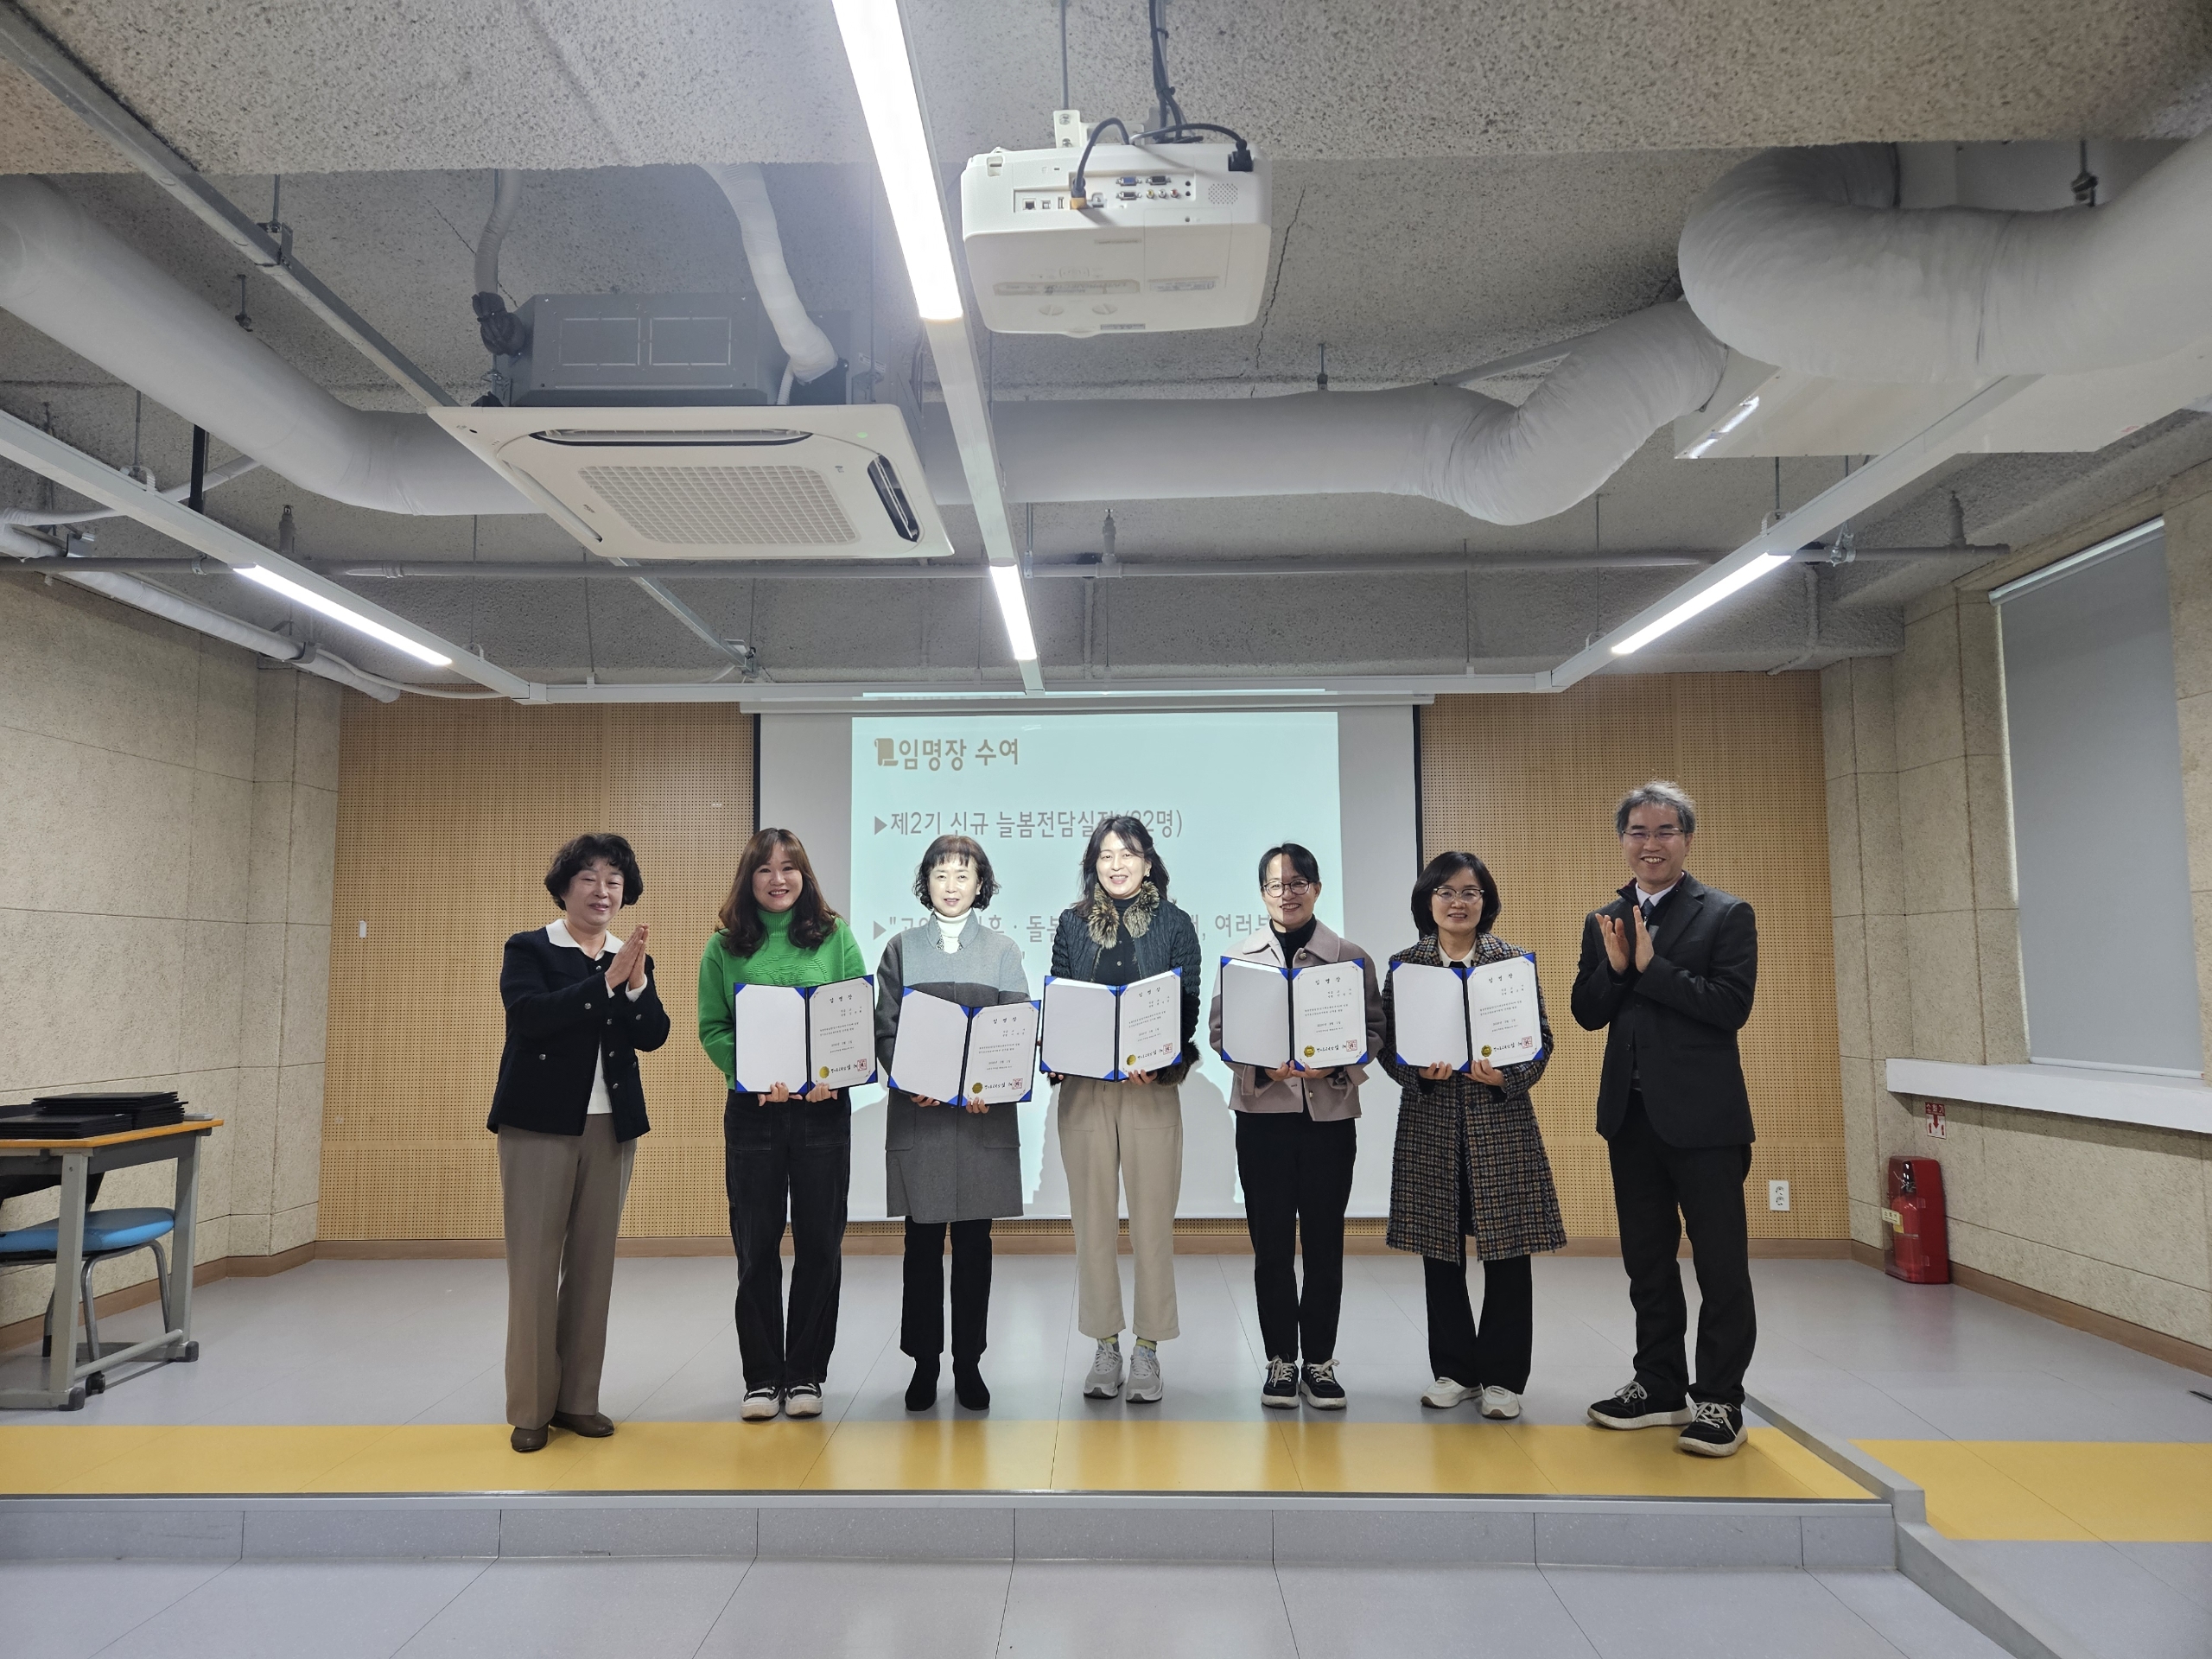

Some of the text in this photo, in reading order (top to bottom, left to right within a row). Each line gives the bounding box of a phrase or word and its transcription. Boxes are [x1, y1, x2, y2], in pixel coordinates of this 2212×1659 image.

[899, 738, 1019, 771] 임명장 수여
[890, 810, 941, 835] 제2기
[950, 811, 989, 835] 신규
